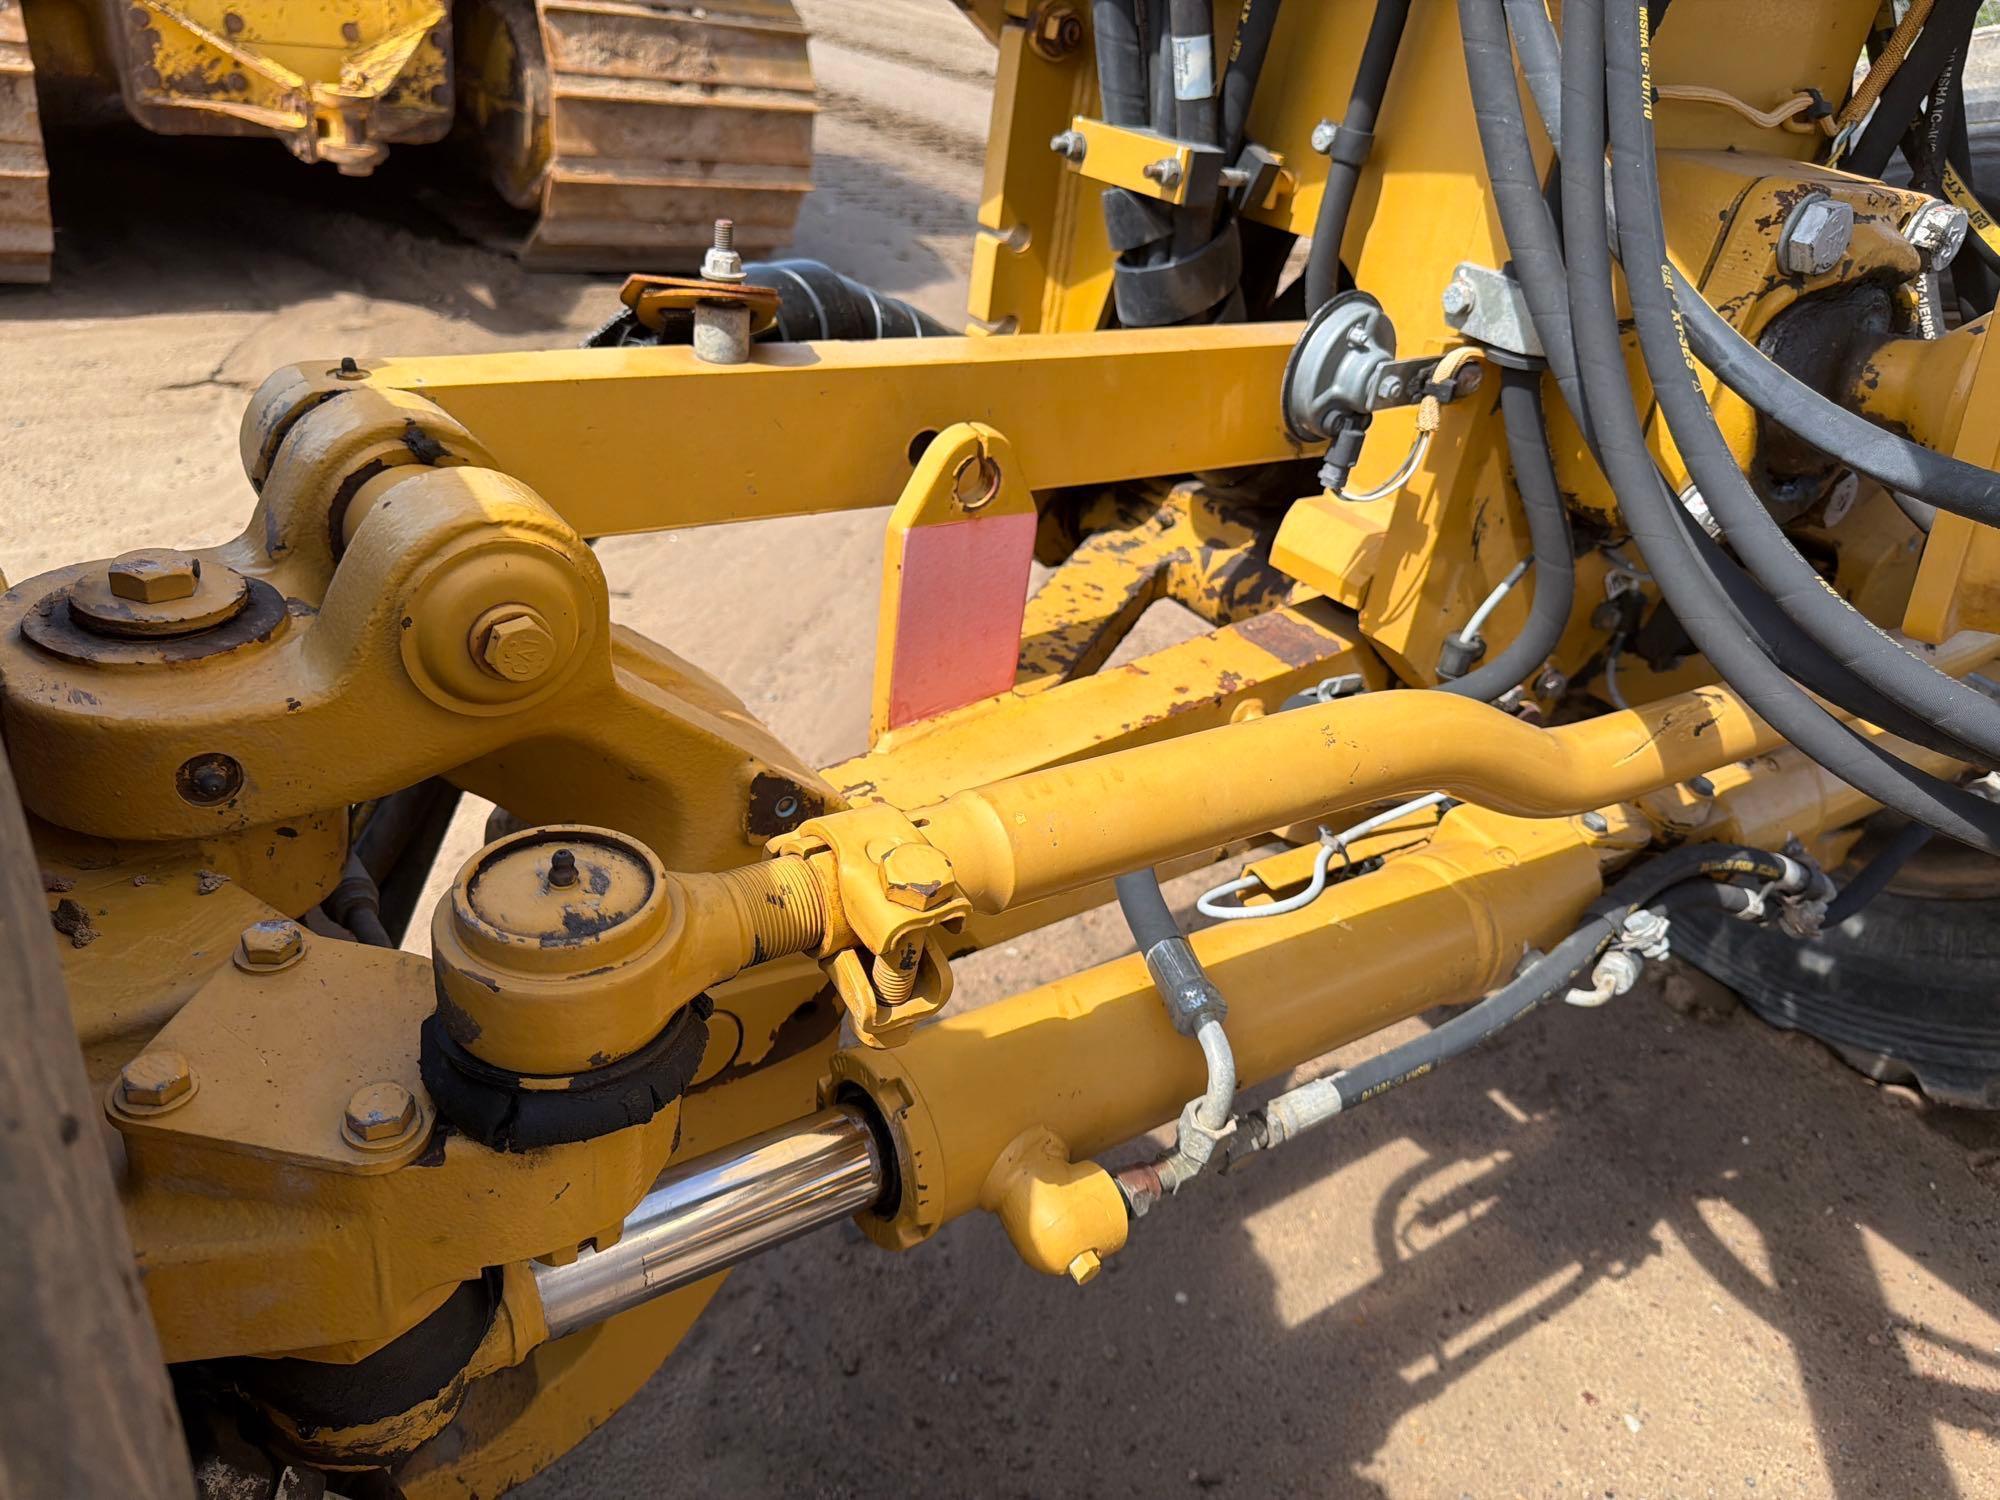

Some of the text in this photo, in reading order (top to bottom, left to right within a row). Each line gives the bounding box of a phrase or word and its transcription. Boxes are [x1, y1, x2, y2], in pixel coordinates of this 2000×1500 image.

[1639, 6, 1653, 120] MSHA IC-101/10
[1660, 264, 1675, 290] CAT
